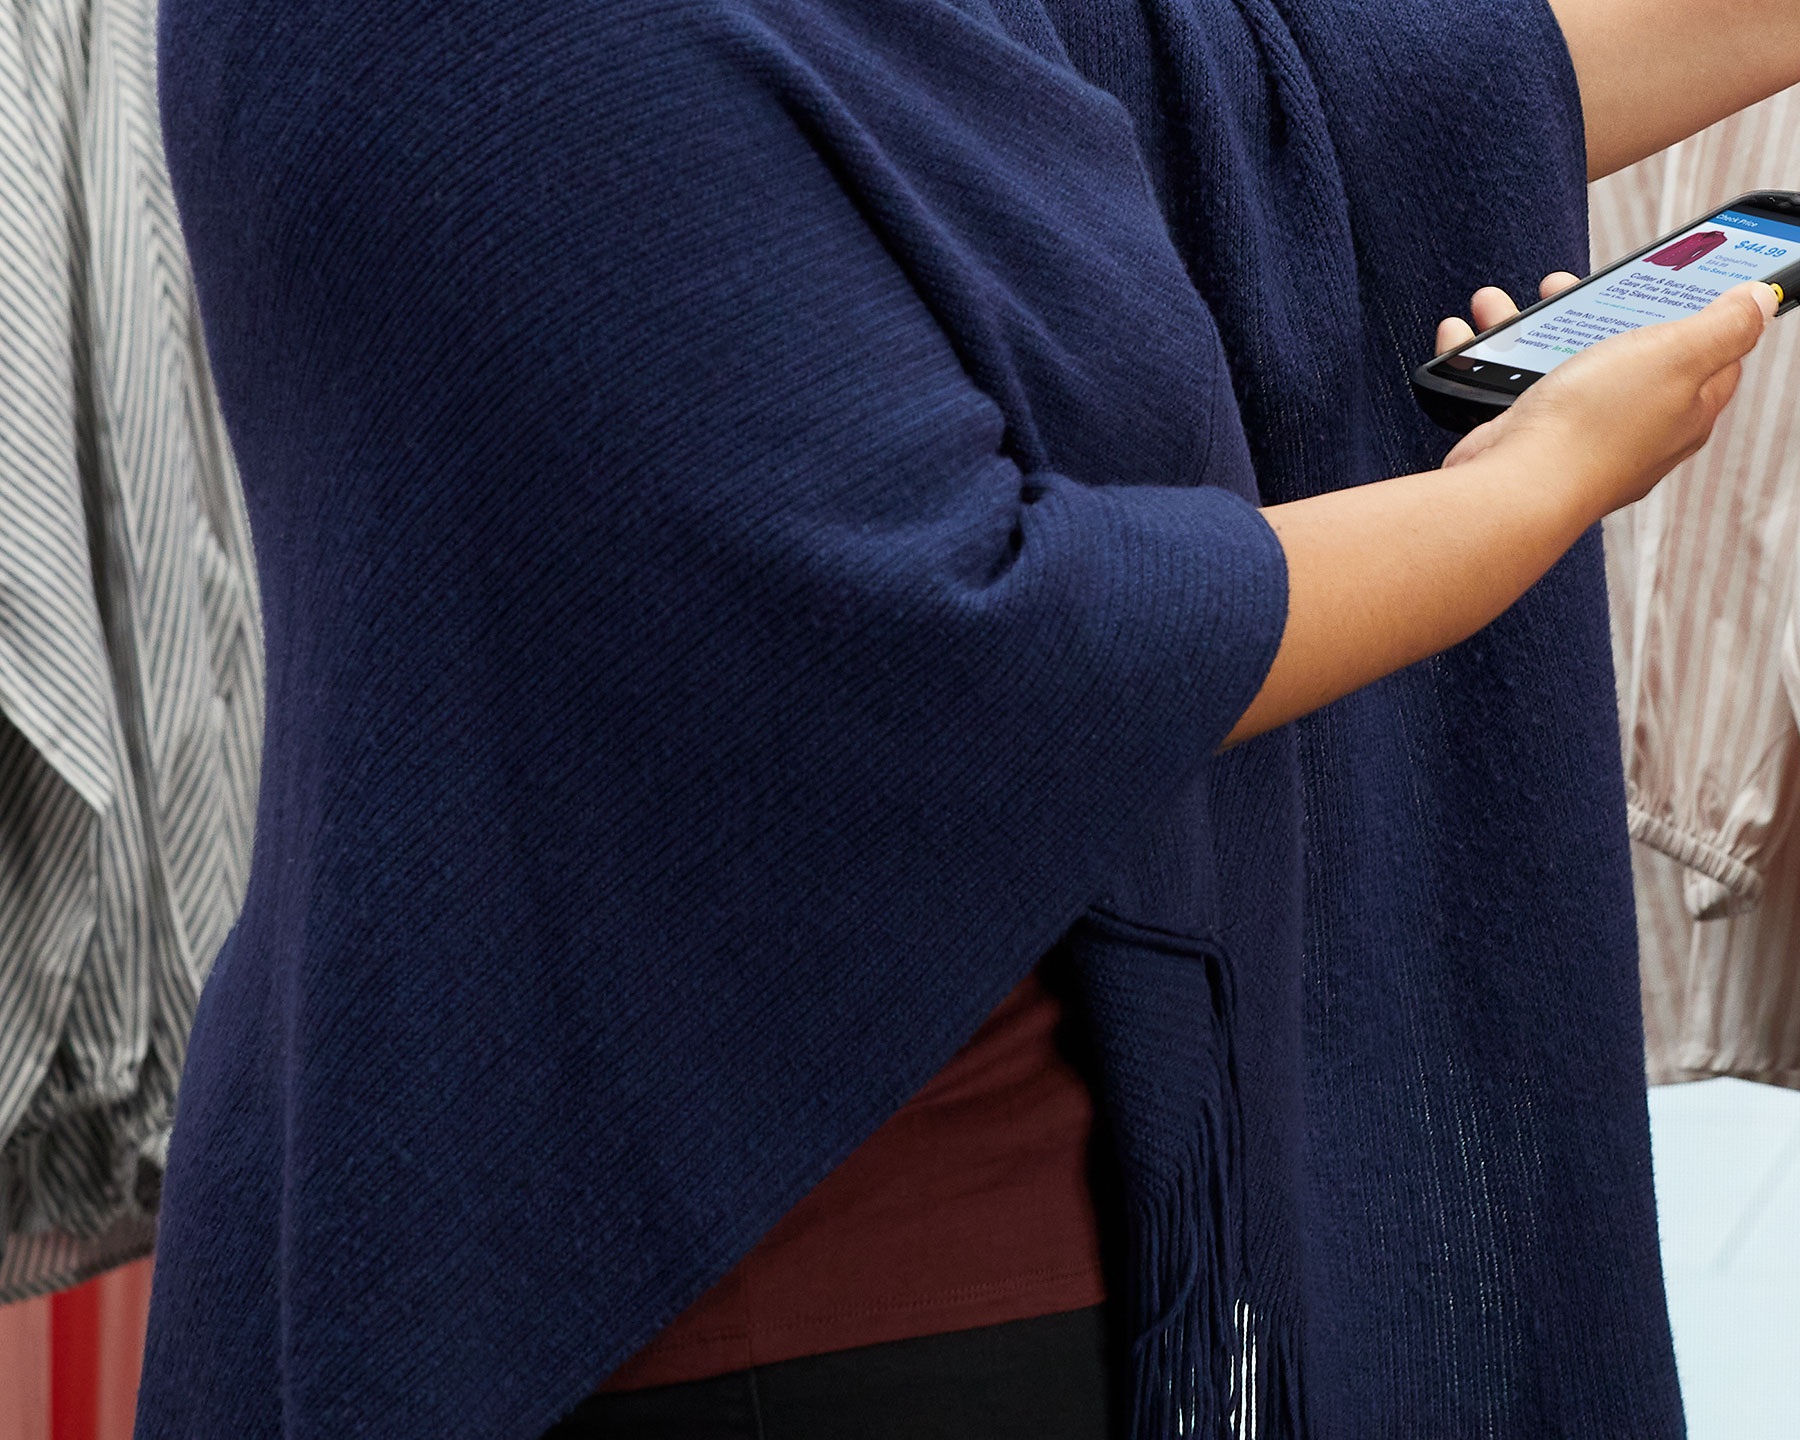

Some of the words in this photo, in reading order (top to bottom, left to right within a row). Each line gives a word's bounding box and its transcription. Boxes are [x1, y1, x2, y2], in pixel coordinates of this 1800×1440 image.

[1716, 213, 1739, 225] Check
[1738, 218, 1759, 228] Price
[1735, 240, 1787, 258] $44.99
[1714, 255, 1741, 264] Original
[1740, 260, 1758, 268] Price
[1618, 279, 1641, 288] Care
[1640, 283, 1660, 292] Fine
[1661, 288, 1681, 296] Twill
[1630, 272, 1657, 282] Cutter
[1664, 279, 1686, 289] Buck
[1685, 285, 1706, 294] Epic
[1606, 285, 1630, 296] Long
[1629, 290, 1659, 301] Sleeve
[1657, 296, 1685, 307] Dress
[1565, 309, 1583, 318] Item
[1576, 321, 1611, 332] Cardinal
[1563, 338, 1584, 346] Aisle
